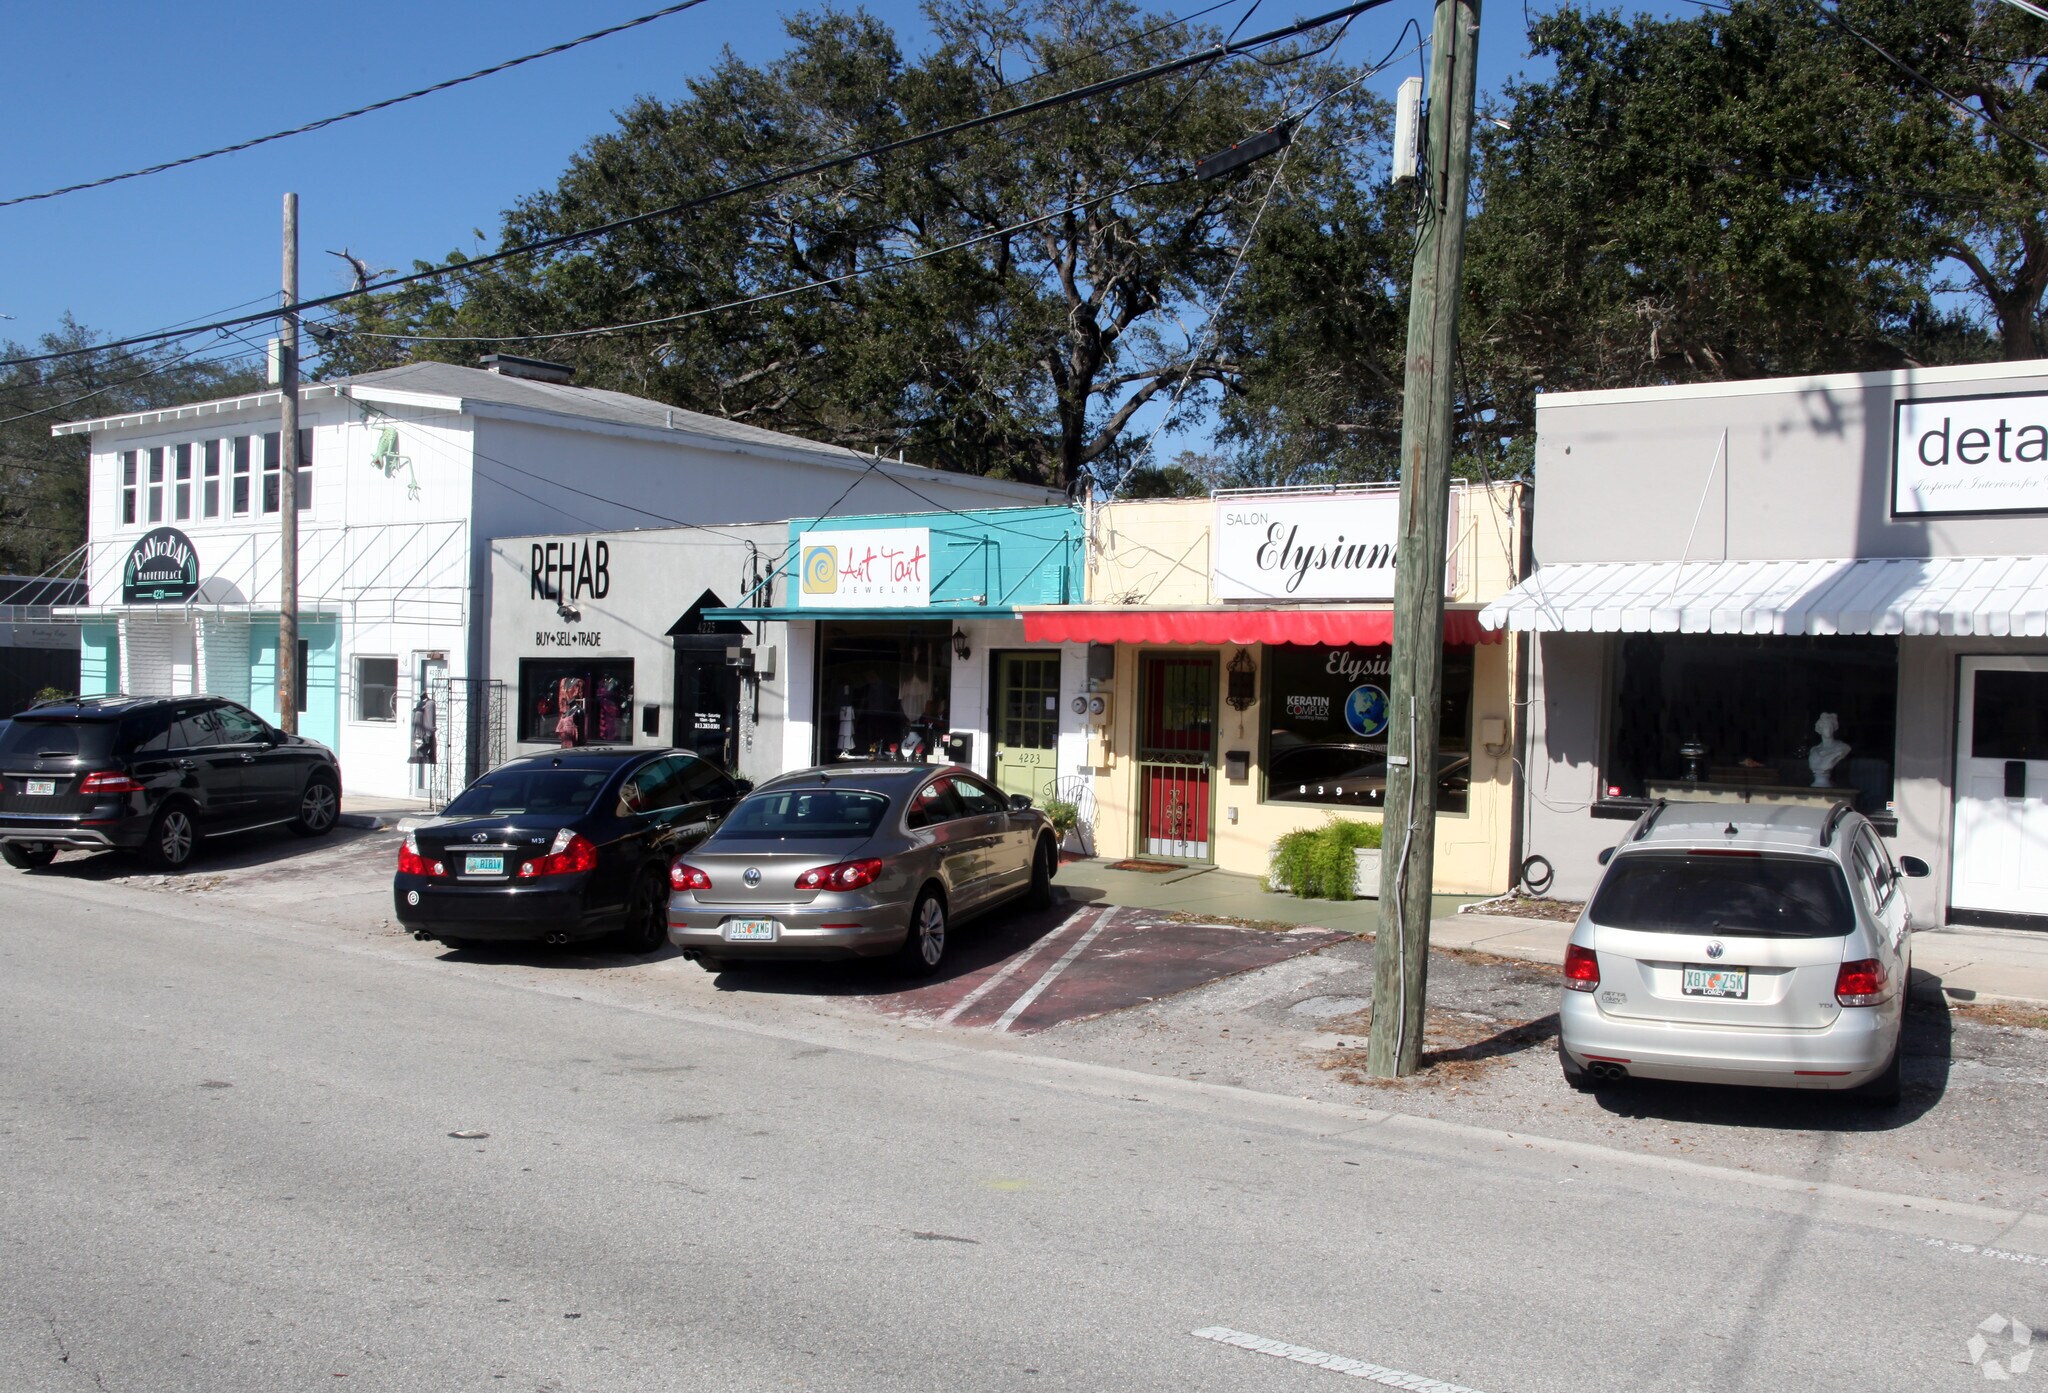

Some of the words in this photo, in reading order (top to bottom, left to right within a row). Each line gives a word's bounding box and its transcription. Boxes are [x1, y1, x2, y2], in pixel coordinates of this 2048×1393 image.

[1910, 478, 1963, 495] Inspired
[1964, 475, 2020, 489] Interiors
[2018, 477, 2039, 491] for
[1226, 513, 1268, 525] SALON
[839, 546, 877, 582] Art
[881, 545, 926, 582] Tart
[1256, 522, 1398, 593] Elysium
[531, 538, 610, 601] REHAB
[842, 586, 921, 594] JEWELRY
[697, 622, 716, 633] 4225
[536, 632, 551, 646] BUY
[556, 632, 571, 646] SELL
[578, 632, 601, 646] TRADE
[1326, 651, 1392, 682] Elysiu
[1287, 696, 1329, 706] KERATIN
[1287, 705, 1329, 716] COMPLEX
[1019, 753, 1041, 765] 4223
[1299, 785, 1377, 798] 839.4
[733, 923, 747, 934] J15
[1722, 974, 1743, 990] ZSK
